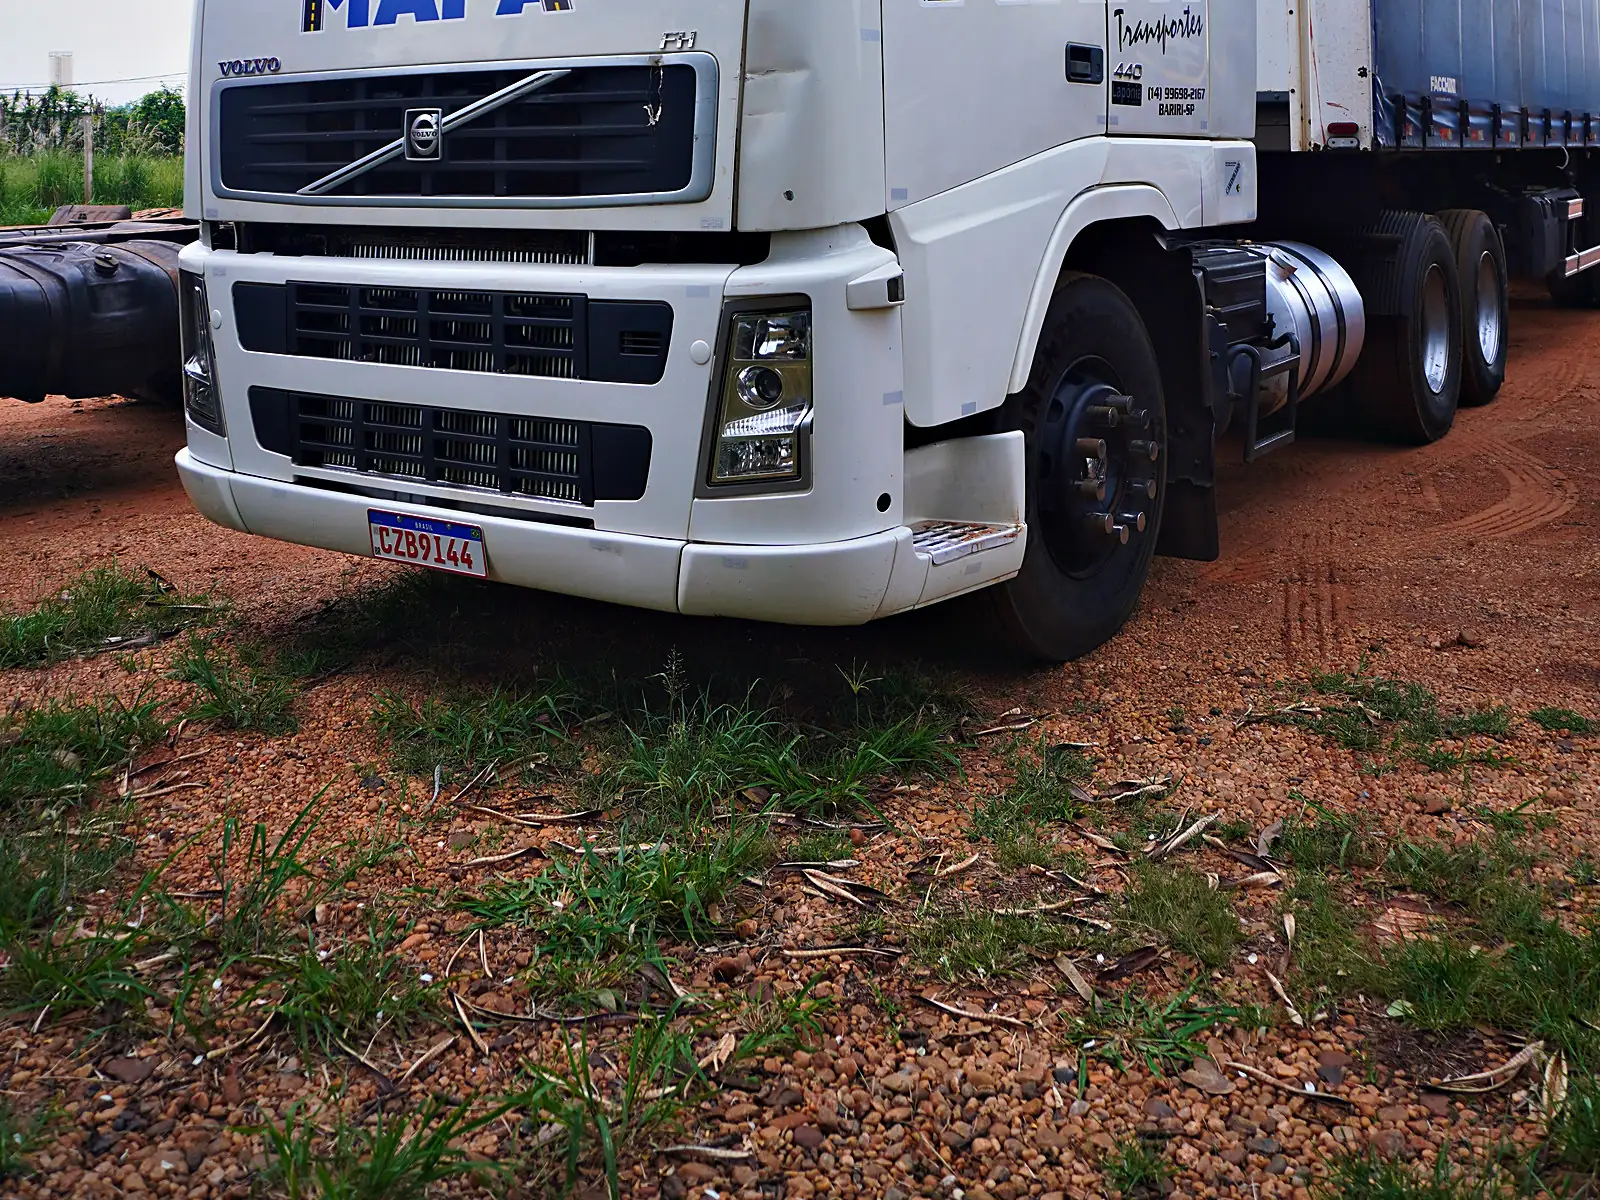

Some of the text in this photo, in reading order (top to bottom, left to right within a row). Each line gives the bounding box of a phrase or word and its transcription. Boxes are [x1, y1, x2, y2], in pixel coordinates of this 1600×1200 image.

[1113, 4, 1204, 55] Transportes
[659, 30, 697, 49] FH
[217, 56, 281, 77] VOLVO
[1113, 62, 1143, 80] 440
[1147, 86, 1206, 101] (14) 99698-2167
[1430, 75, 1457, 94] FACCHINI
[411, 130, 439, 138] VOLVO
[414, 521, 434, 532] BRASIL
[378, 526, 473, 569] CZB9I44
